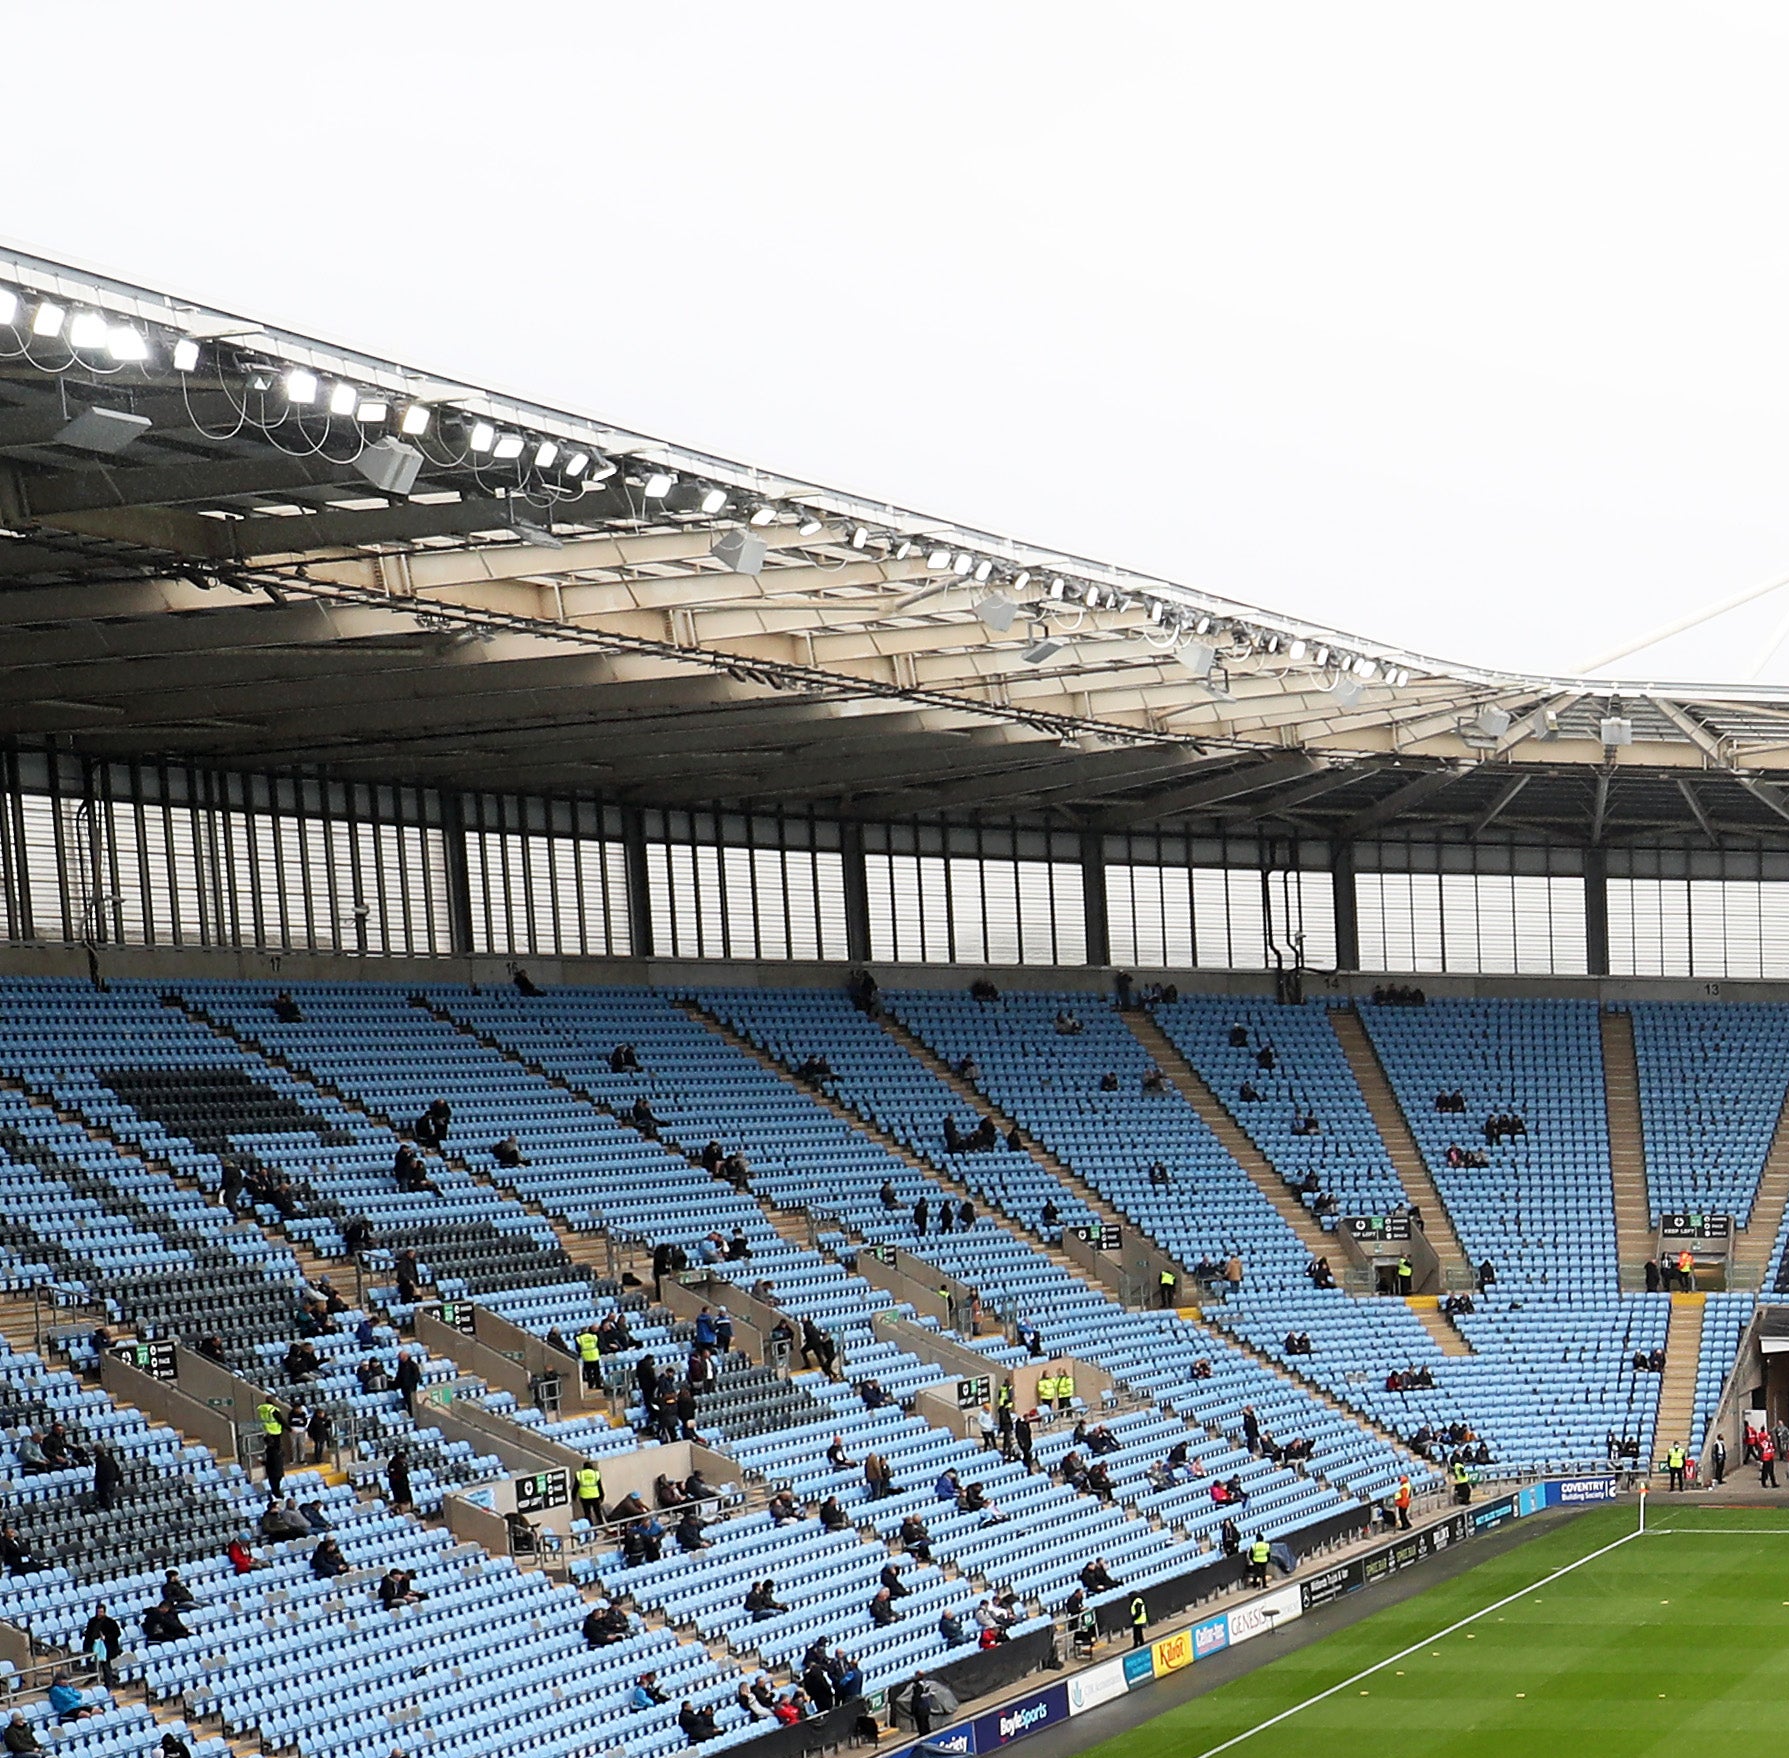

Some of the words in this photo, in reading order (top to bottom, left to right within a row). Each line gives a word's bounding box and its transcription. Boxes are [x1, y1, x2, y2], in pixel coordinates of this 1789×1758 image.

[1560, 1481, 1605, 1493] COVENTRY
[1231, 1605, 1268, 1637] GENESIS
[1000, 1701, 1048, 1738] BoyleSports
